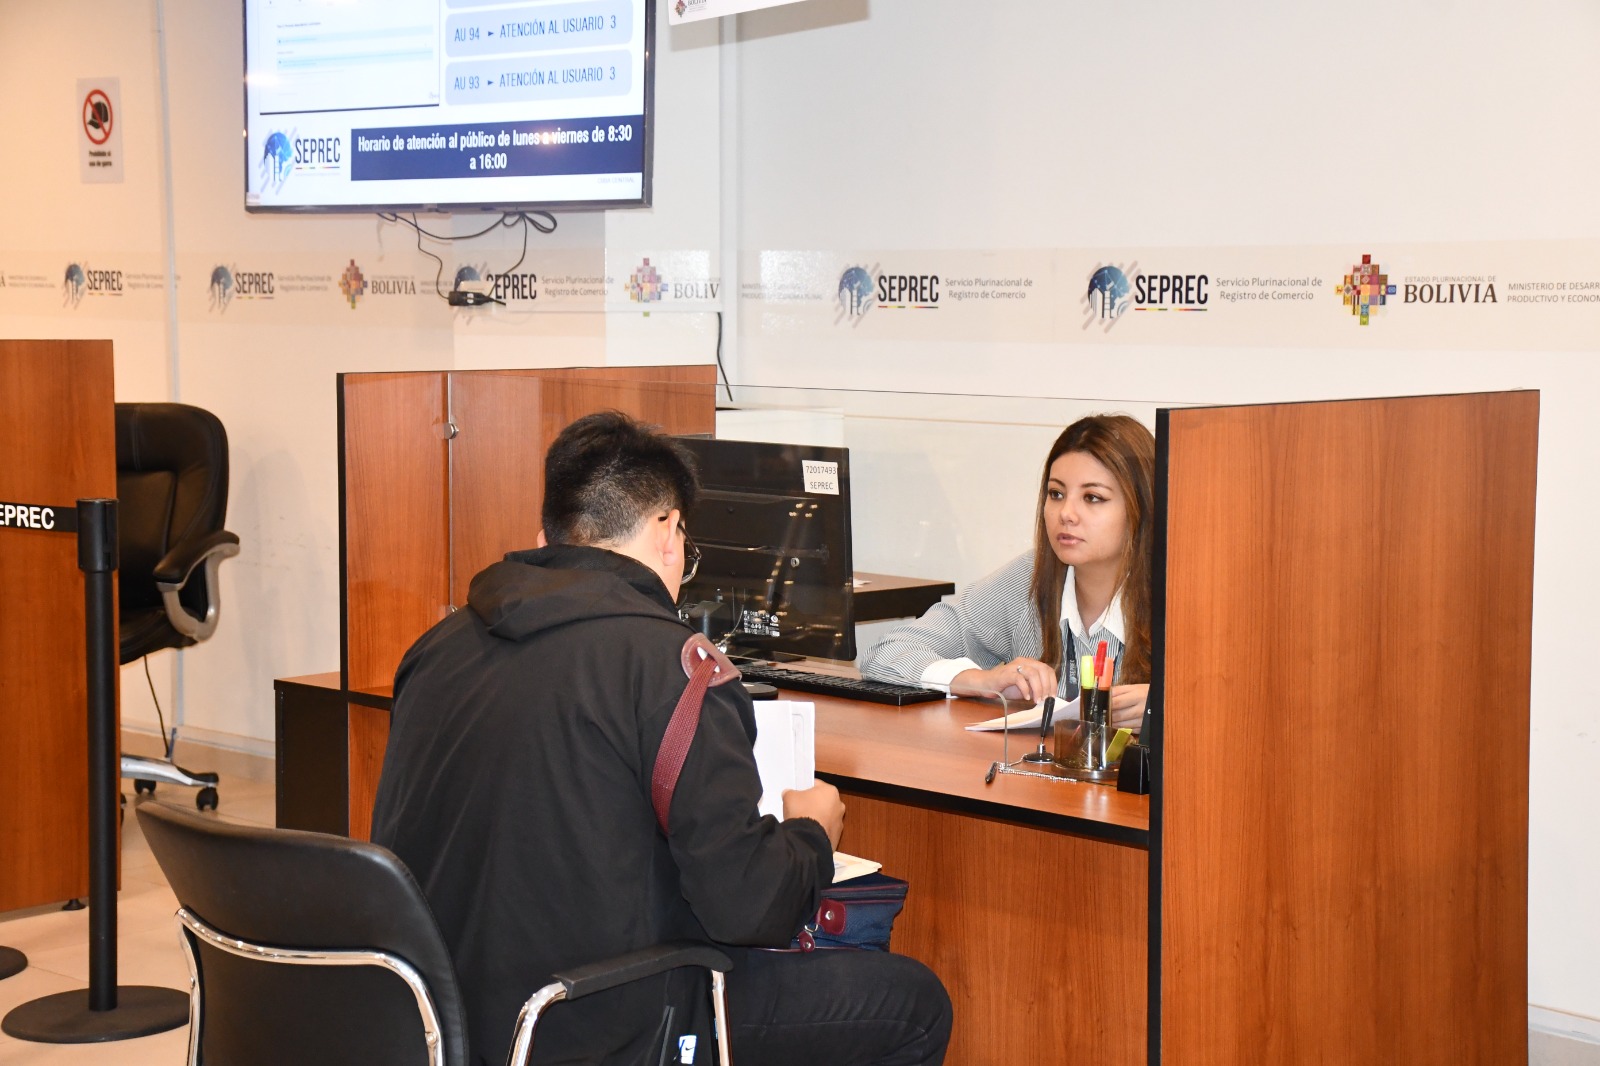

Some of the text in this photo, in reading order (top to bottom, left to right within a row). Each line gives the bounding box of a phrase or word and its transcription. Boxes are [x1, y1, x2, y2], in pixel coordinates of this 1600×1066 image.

[454, 15, 617, 42] AU 94 ATENCIÓN AL USUARIO 3
[454, 66, 616, 90] AU 93 ATENCIÓN AL USUARIO 3
[358, 124, 632, 152] Horario de atención al público de lunes a viernes de 8:30
[295, 138, 340, 164] SEPREC
[470, 153, 508, 170] a 16:00
[87, 270, 123, 290] SEPREC
[235, 272, 274, 294] SEPREC
[371, 281, 416, 294] BOLIVIA
[542, 276, 564, 284] Servicio
[945, 278, 1032, 286] Servicio Plurinacional de
[1216, 277, 1322, 286] Servicio Plurinacional de
[545, 288, 570, 297] Registro
[674, 283, 719, 299] BOLIV
[878, 275, 939, 302] SEPREC
[948, 290, 1026, 301] Registro de Comercio
[1134, 274, 1208, 304] SEPREC
[1220, 291, 1314, 302] Registro de Comercio
[1404, 284, 1498, 303] BOLIVIA
[806, 466, 836, 474] 72017493
[810, 482, 834, 490] SEPREC
